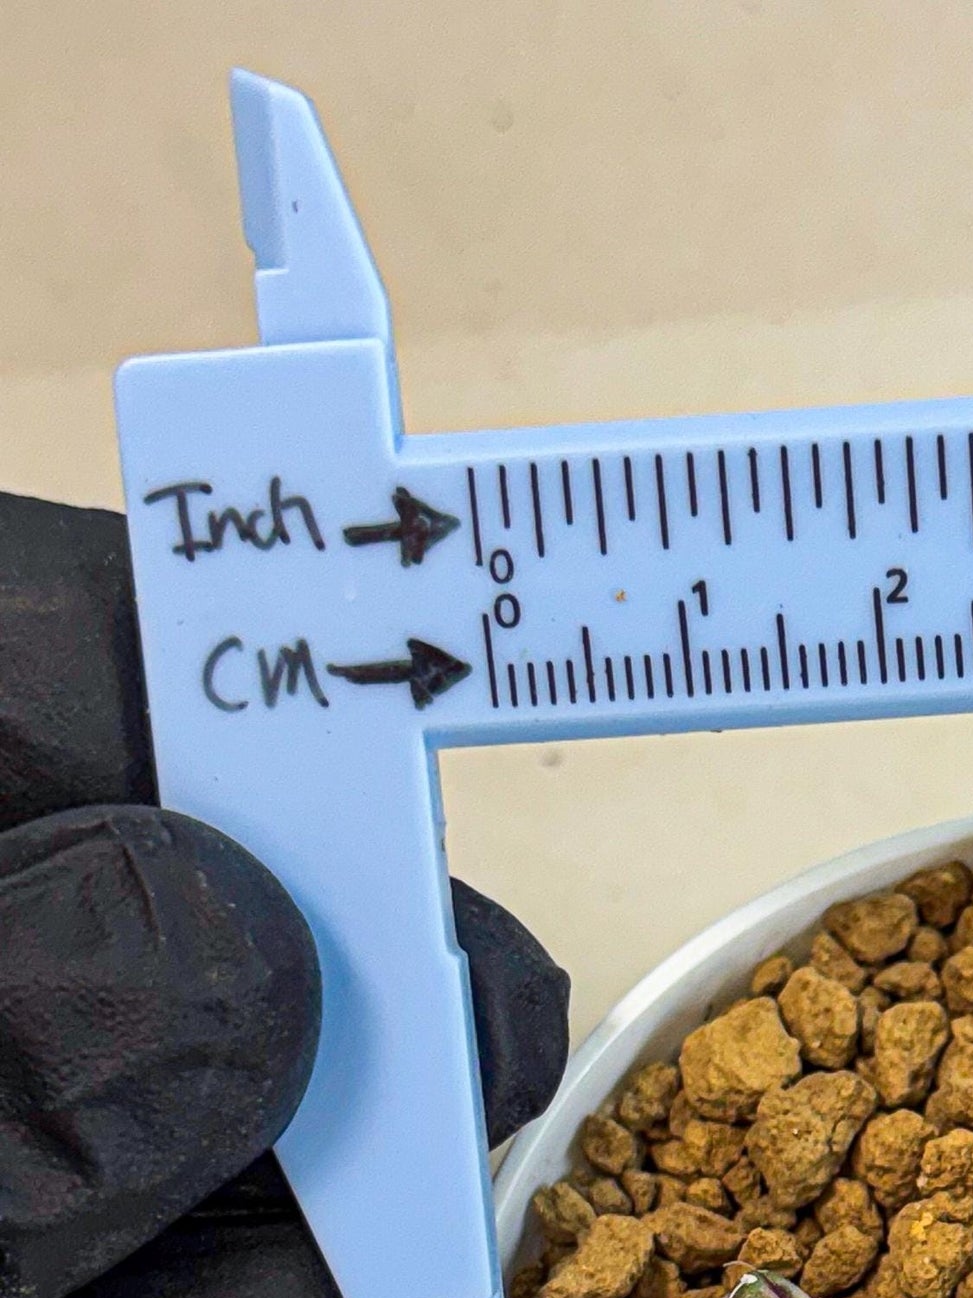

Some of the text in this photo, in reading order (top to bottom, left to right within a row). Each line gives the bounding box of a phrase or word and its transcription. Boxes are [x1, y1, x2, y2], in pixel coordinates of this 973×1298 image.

[143, 476, 326, 561] Inch
[489, 548, 514, 584] 0
[494, 594, 521, 628] 0
[692, 580, 709, 616] 1
[886, 568, 909, 603] 2
